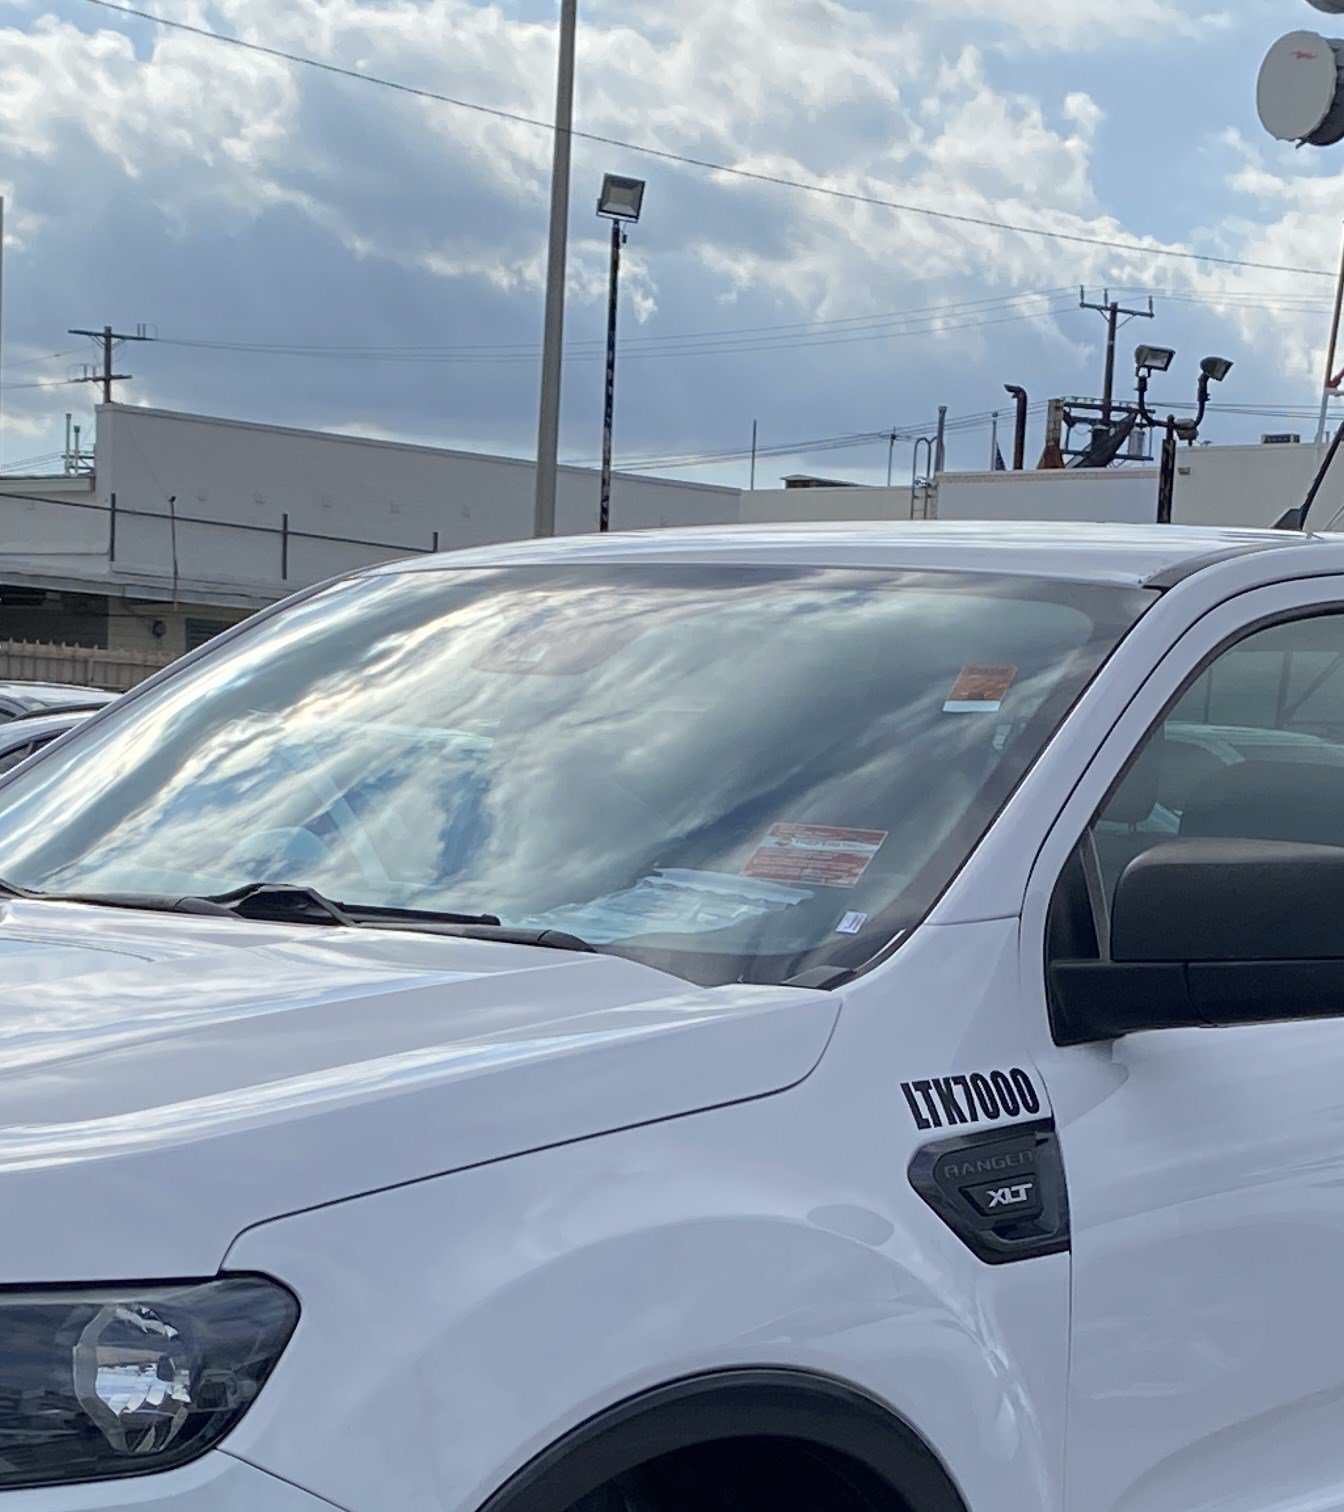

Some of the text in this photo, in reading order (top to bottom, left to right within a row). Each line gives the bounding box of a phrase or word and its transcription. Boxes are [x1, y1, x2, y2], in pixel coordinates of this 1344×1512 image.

[900, 1067, 1040, 1130] LTK7000
[943, 1150, 1033, 1178] RANGER
[987, 1182, 1033, 1208] XLT
